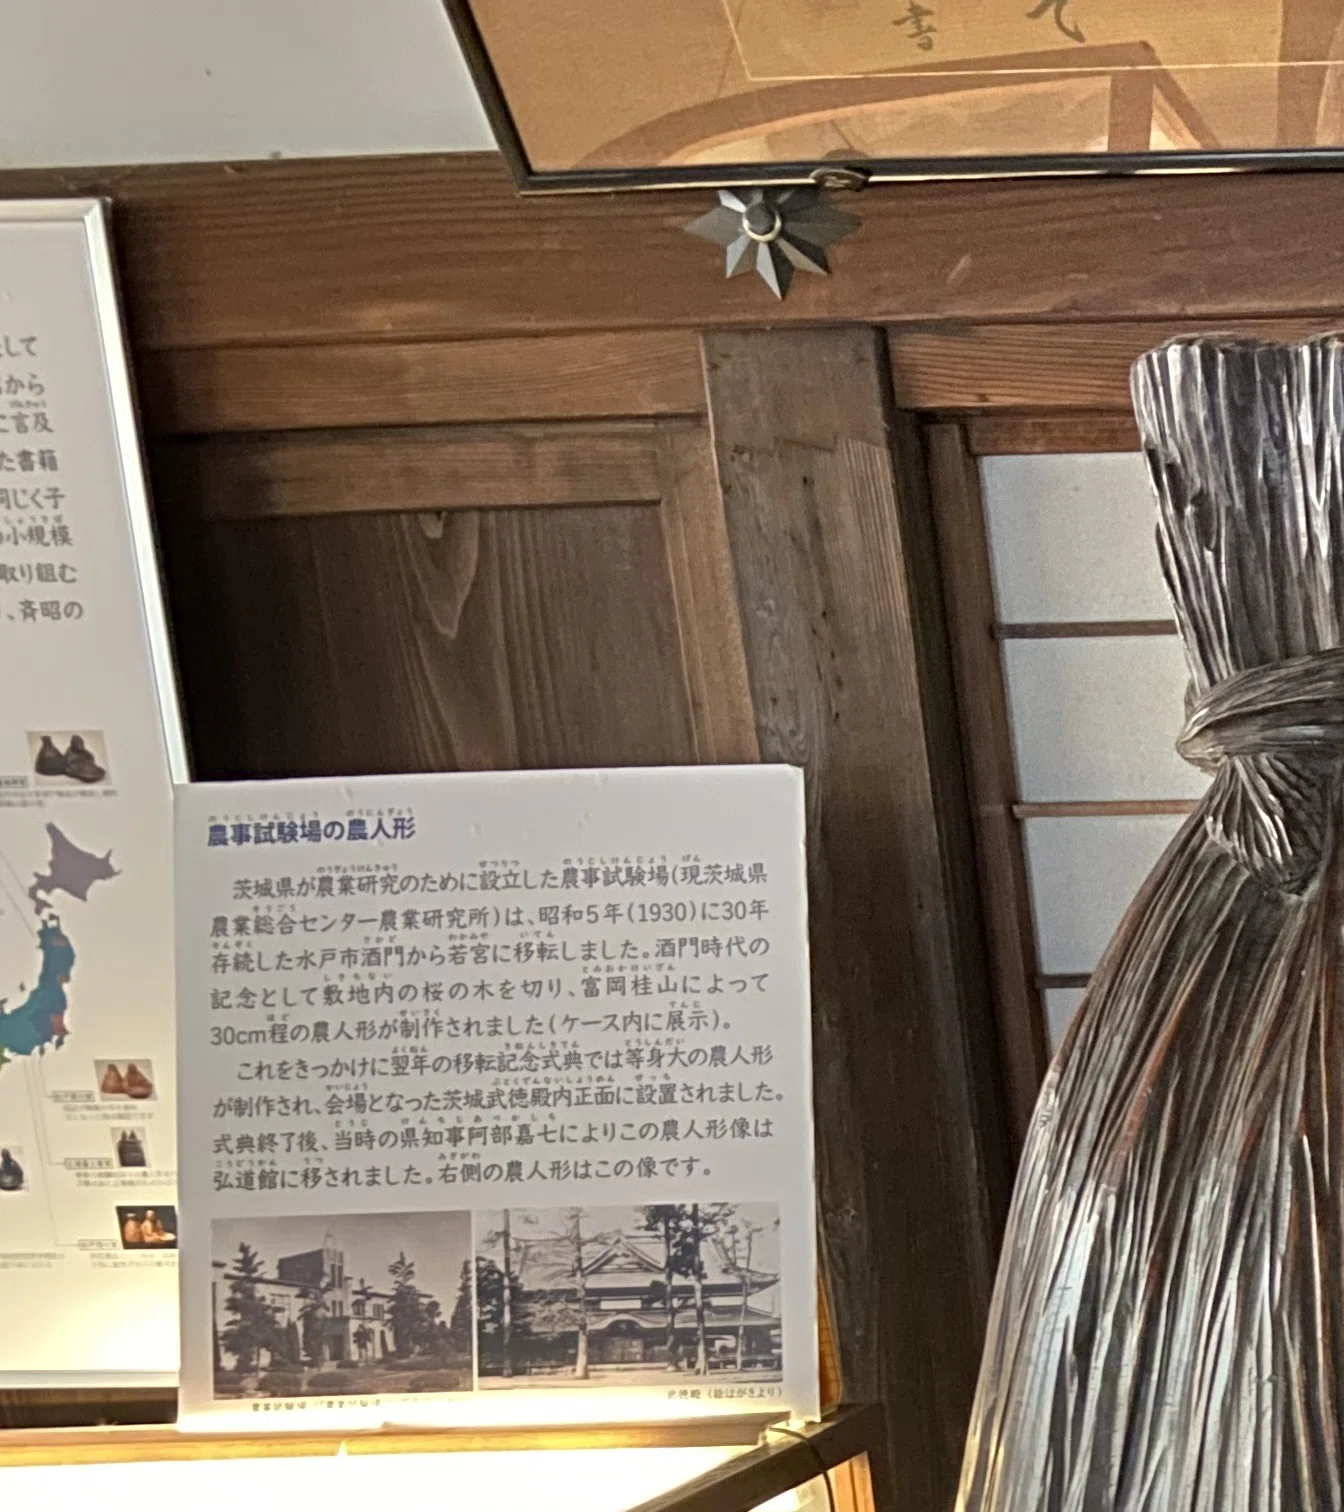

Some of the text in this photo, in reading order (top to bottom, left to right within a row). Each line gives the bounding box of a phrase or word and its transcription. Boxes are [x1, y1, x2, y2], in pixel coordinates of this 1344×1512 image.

[0, 334, 37, 358] して
[0, 373, 45, 396] から
[0, 525, 74, 548] 小規模
[208, 816, 416, 847] 農事試験場の農人形
